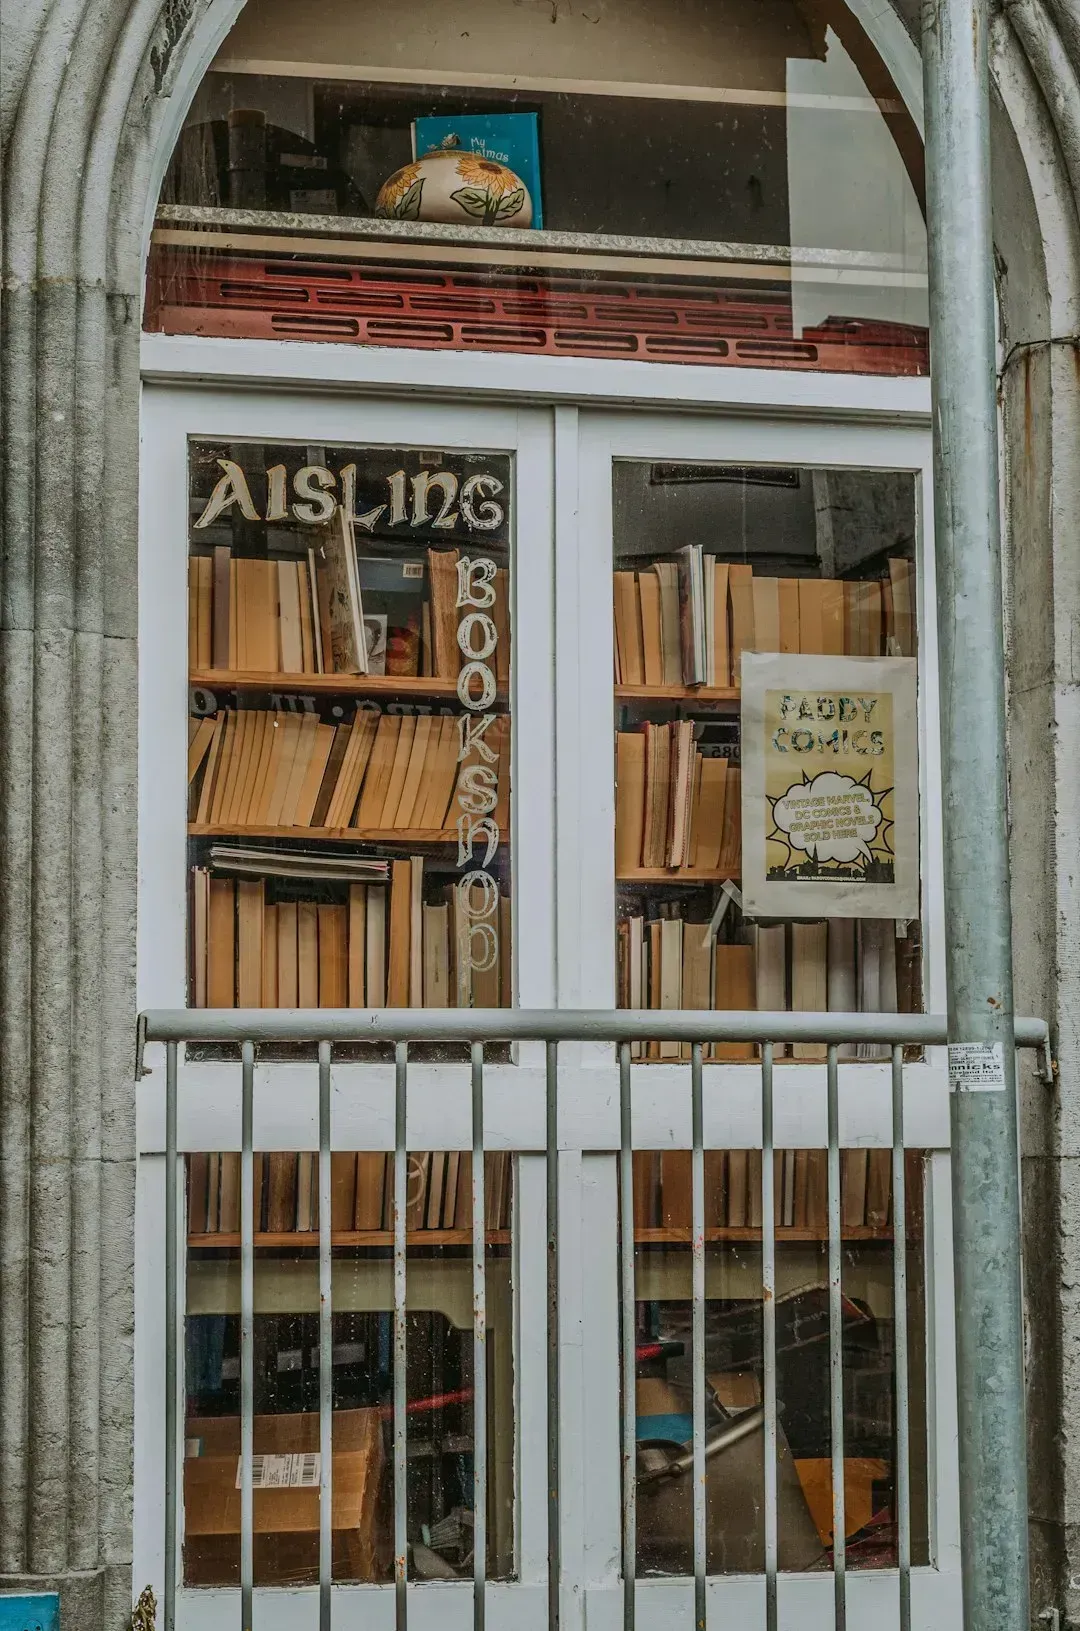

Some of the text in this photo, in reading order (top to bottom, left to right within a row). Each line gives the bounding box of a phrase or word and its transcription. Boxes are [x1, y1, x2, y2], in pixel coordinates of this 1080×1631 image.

[470, 137, 485, 148] My
[780, 695, 878, 723] PADDY
[772, 727, 884, 756] COMICS
[782, 796, 825, 810] VINTAGE
[795, 805, 861, 820] DC COMICS &
[789, 815, 875, 833] GRAPHIC NOVELS
[803, 828, 858, 843] SOLD HERE
